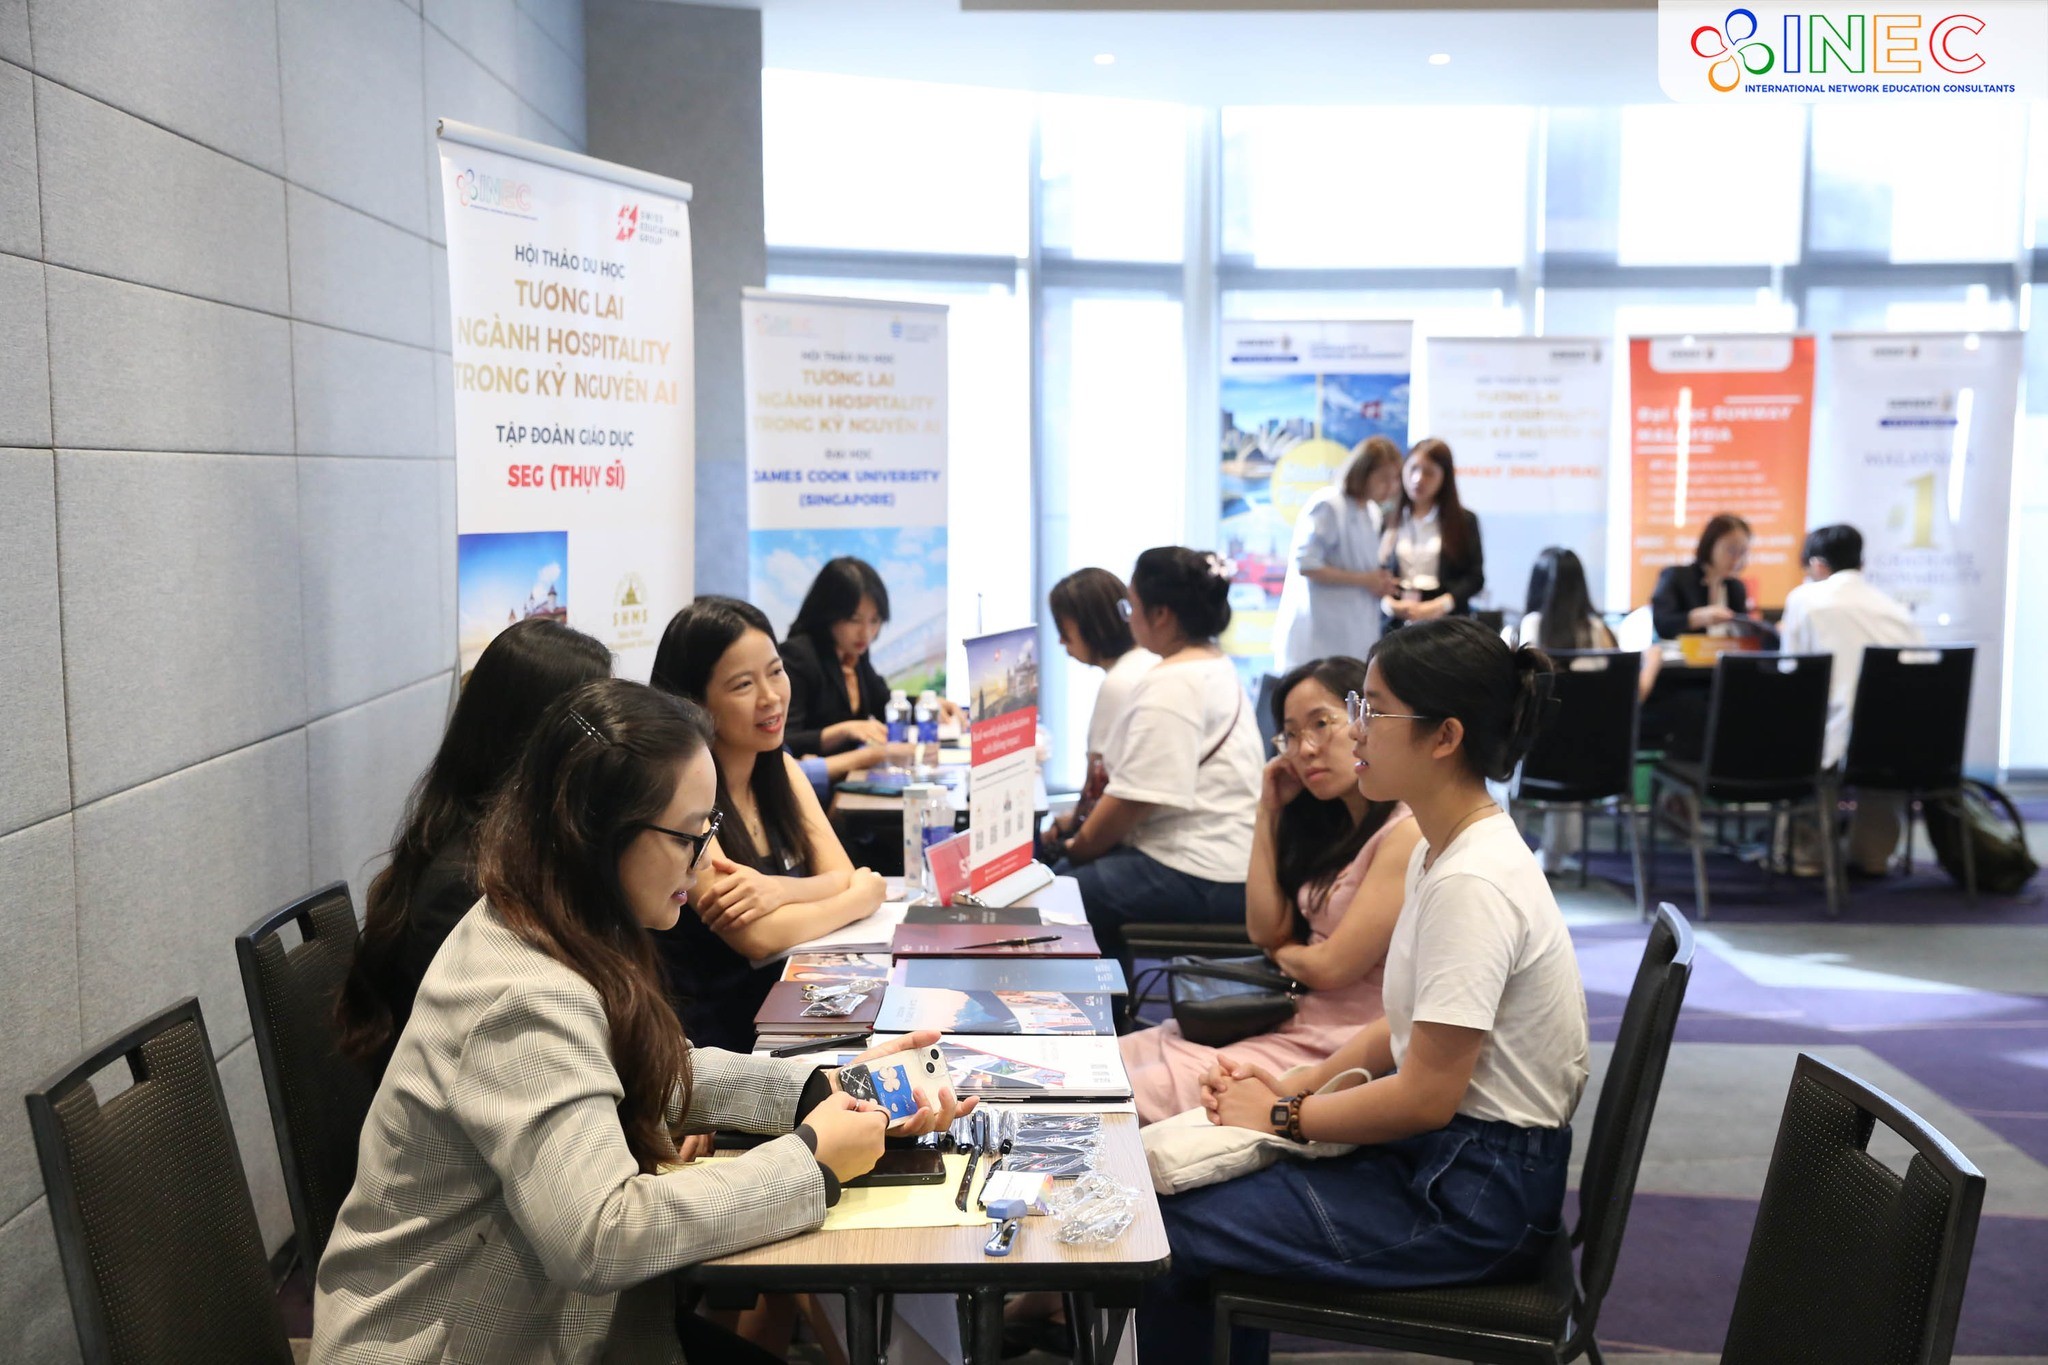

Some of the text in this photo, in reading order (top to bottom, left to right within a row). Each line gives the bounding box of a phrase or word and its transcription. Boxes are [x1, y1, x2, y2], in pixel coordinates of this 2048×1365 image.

[641, 222, 680, 238] EDUCATION
[515, 243, 626, 281] HỘI THẢO DU HỌC
[514, 279, 624, 320] TƯƠNG LAI
[458, 312, 672, 364] NGÀNH HOSPITALITY
[454, 361, 678, 406] TRONG KỶ NGUYÊN AI
[868, 370, 895, 388] LAI
[828, 394, 935, 412] HOSPITALITY
[496, 421, 634, 451] TẬP ĐOÀN GIÁO DỤC
[508, 459, 625, 494] SEG (THỤY SĨ)
[754, 469, 940, 483] JAMES COOK UNIVERSITY
[799, 493, 895, 507] (SINGAPORE)
